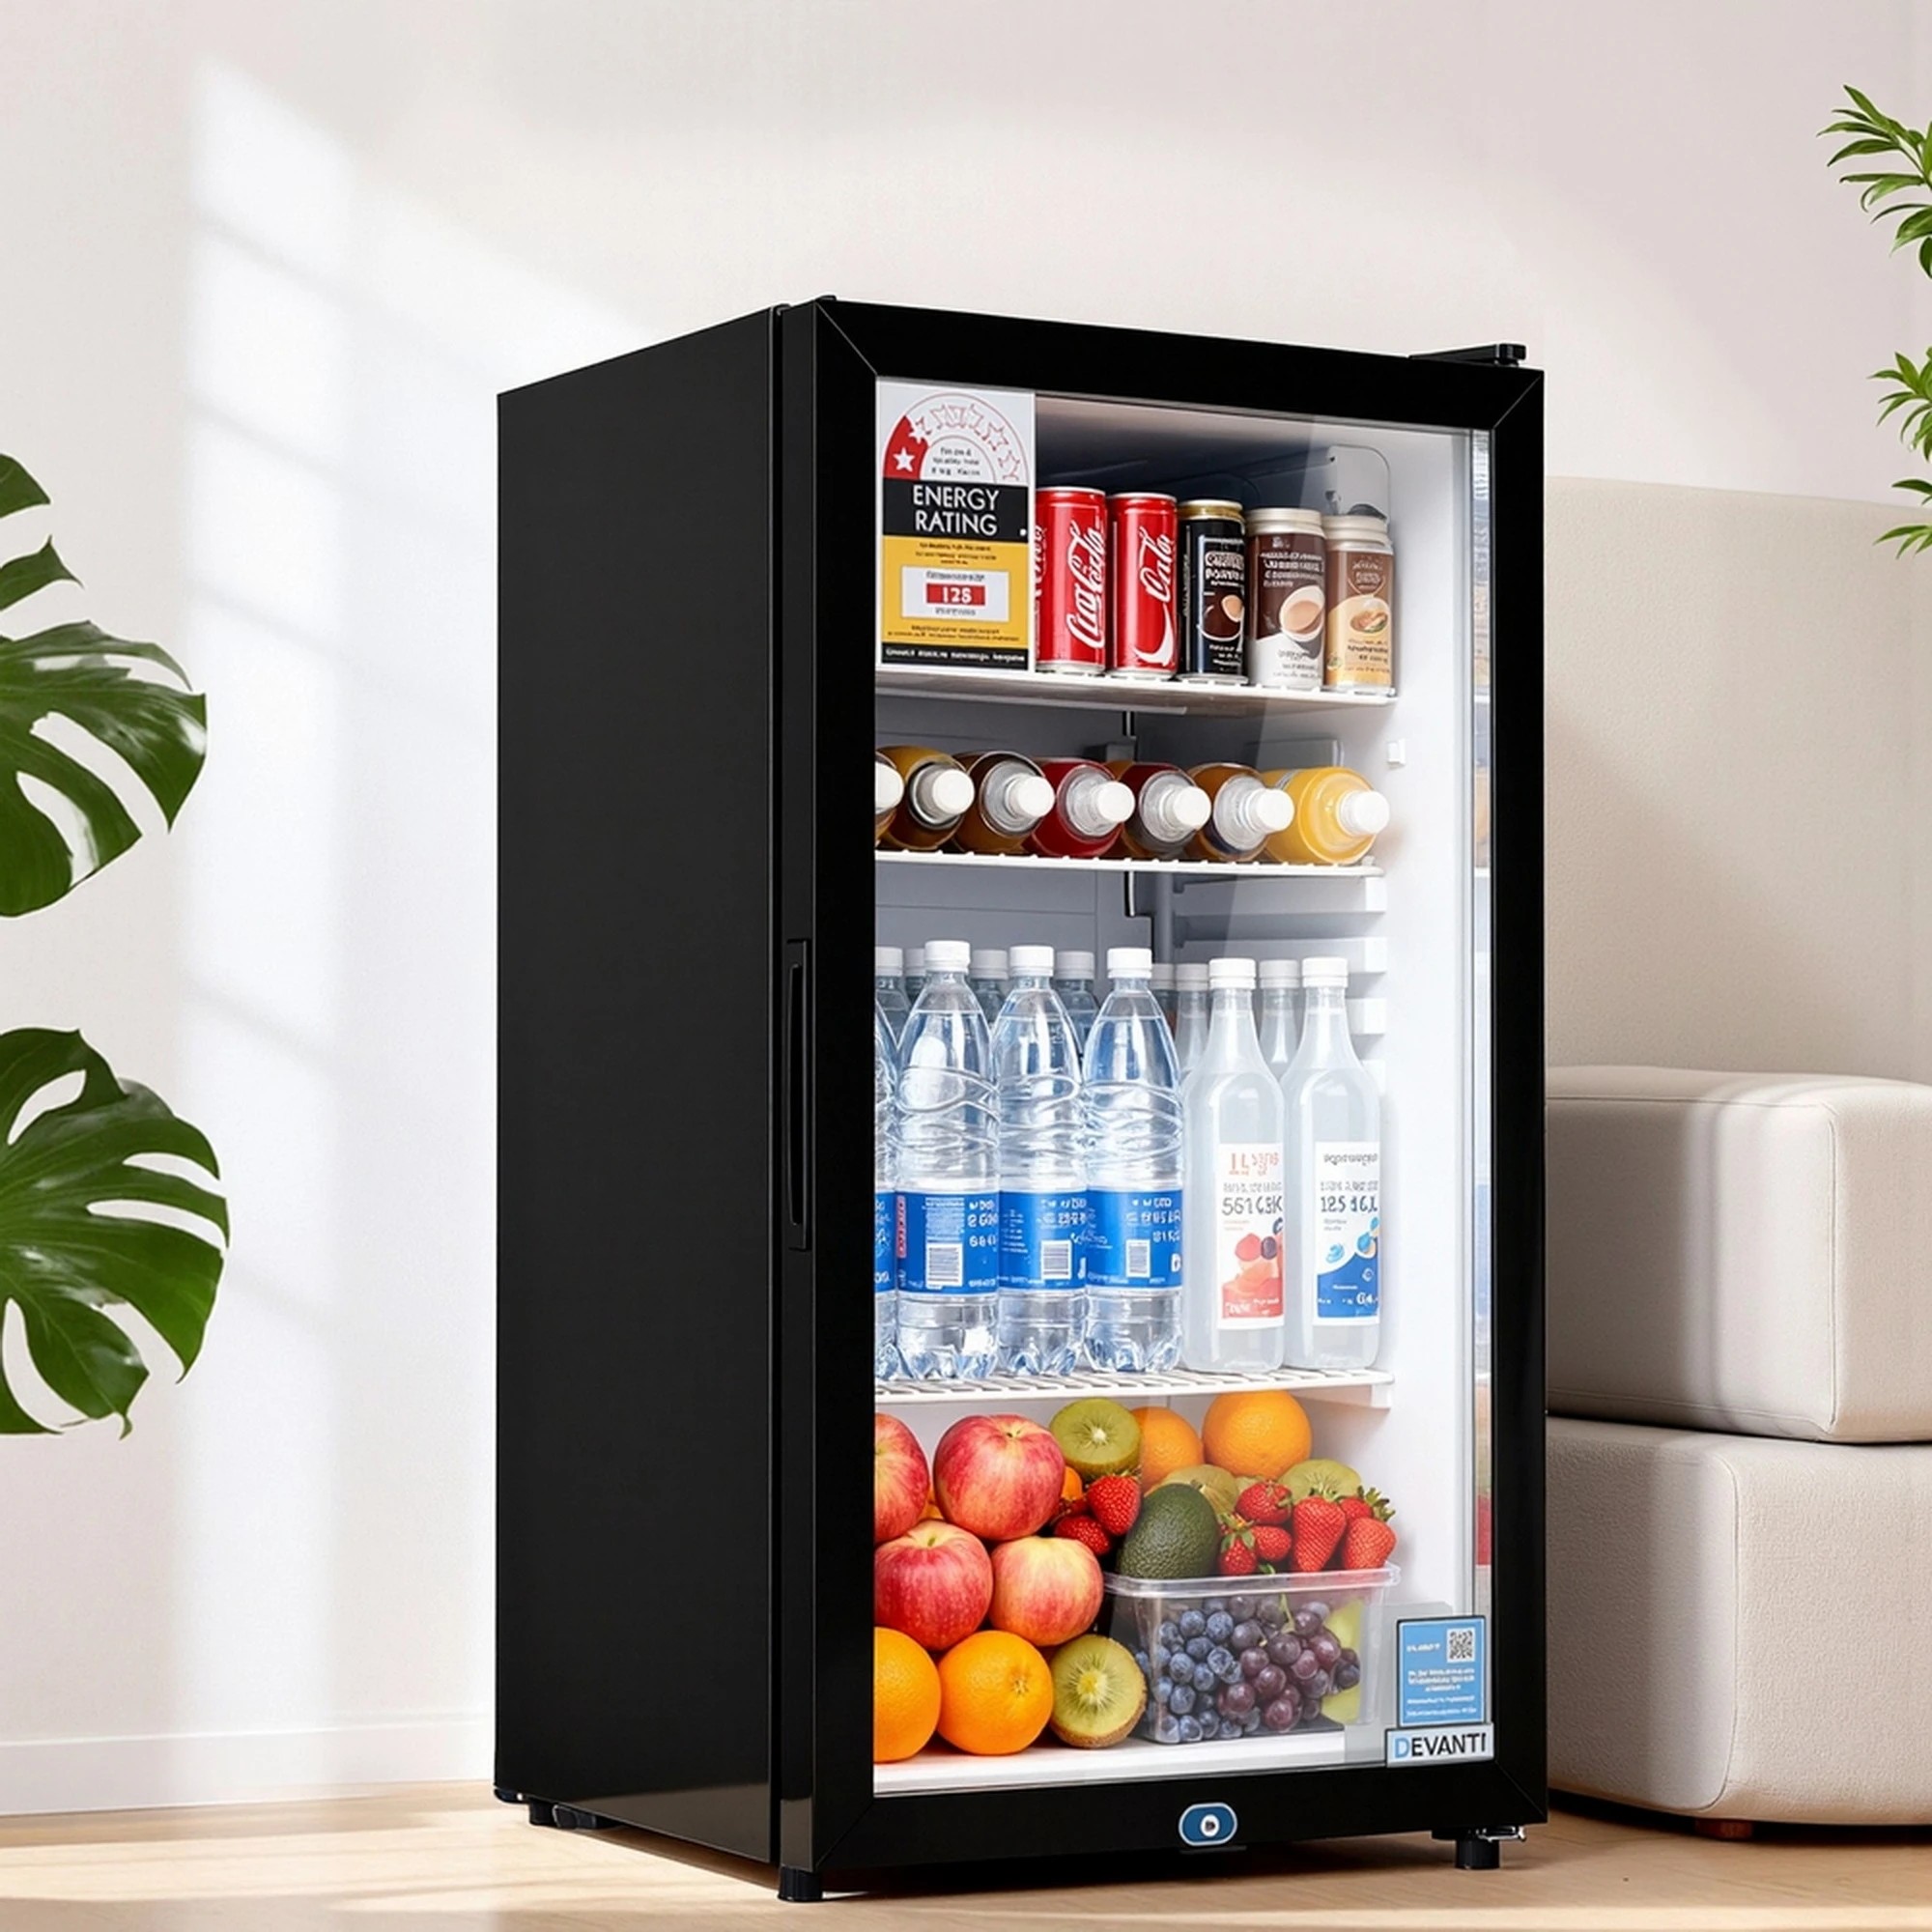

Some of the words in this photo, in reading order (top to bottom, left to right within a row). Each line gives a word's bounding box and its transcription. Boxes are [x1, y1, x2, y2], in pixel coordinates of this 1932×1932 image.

[913, 485, 1000, 511] ENERGY
[915, 510, 998, 536] RATING
[1394, 1732, 1486, 1758] DEVANTI
